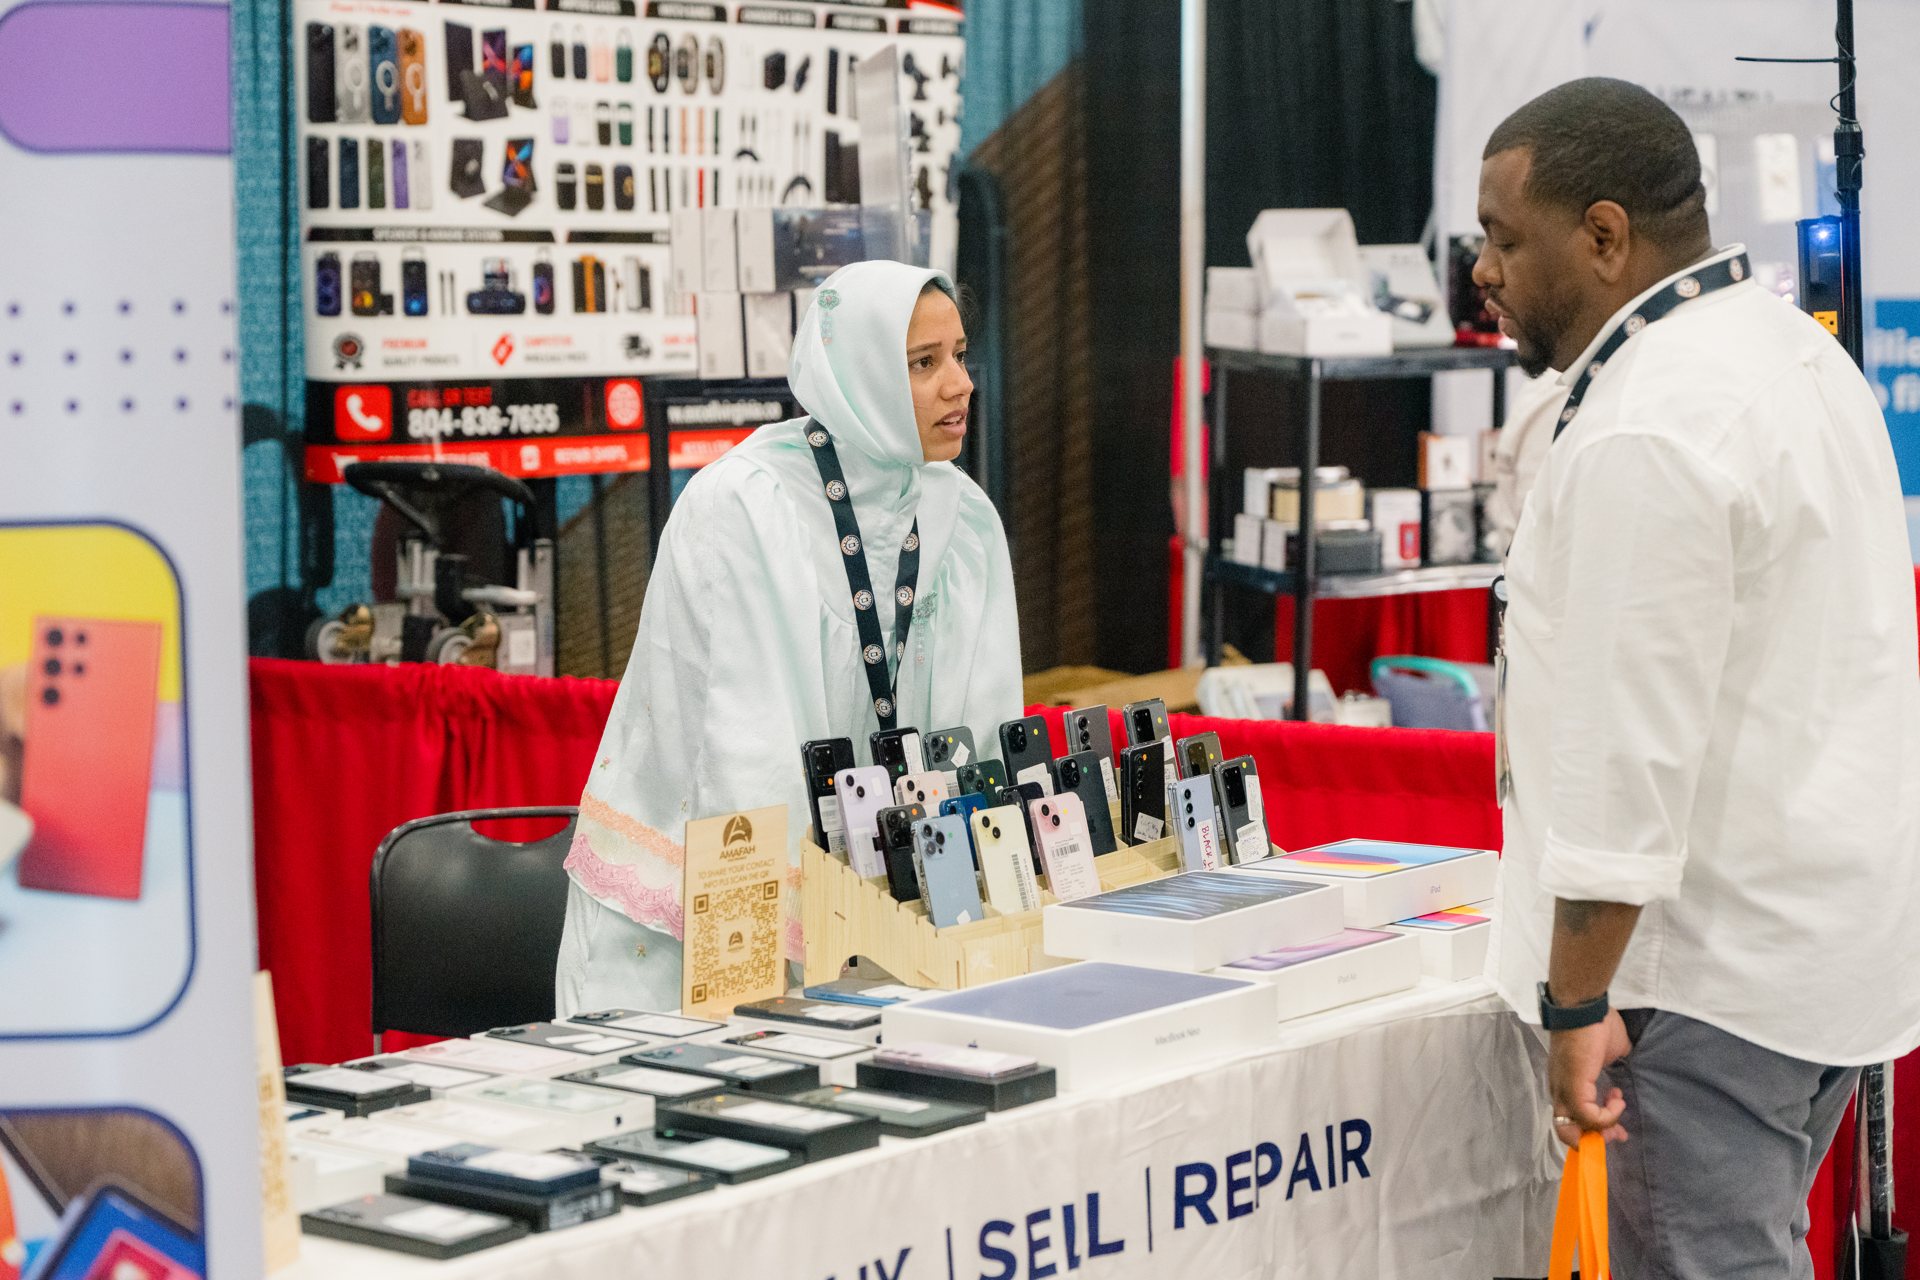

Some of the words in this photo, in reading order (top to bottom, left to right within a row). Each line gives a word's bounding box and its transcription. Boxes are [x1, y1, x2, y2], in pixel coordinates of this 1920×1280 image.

[408, 403, 560, 438] 804-836-7655
[719, 846, 755, 859] AMAFAH
[1201, 825, 1213, 858] BLACK
[746, 858, 775, 870] CONTACT
[1430, 885, 1441, 894] iPad
[979, 1192, 1125, 1280] SELL
[1172, 1118, 1373, 1231] REPAIR
